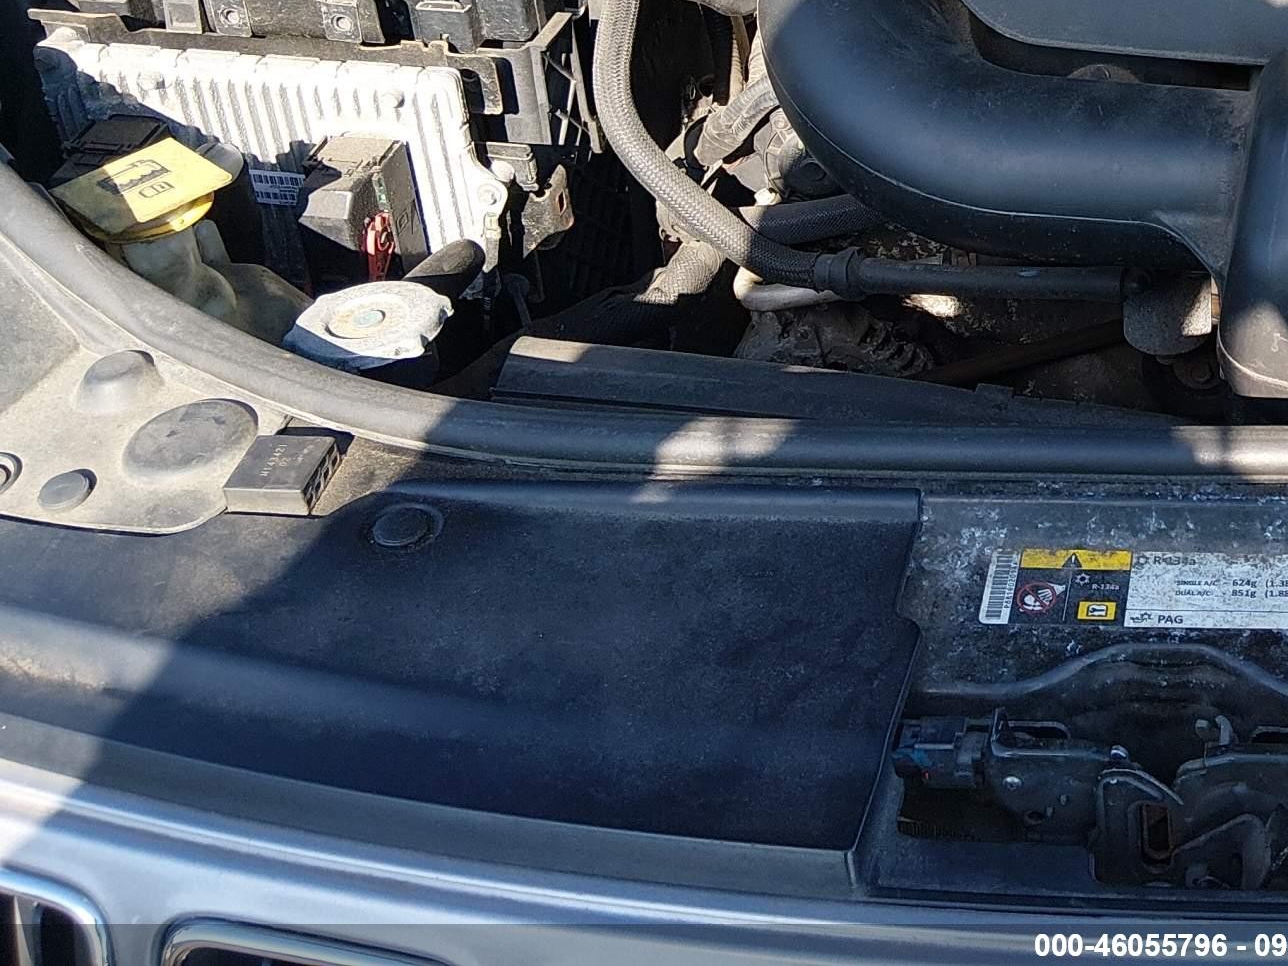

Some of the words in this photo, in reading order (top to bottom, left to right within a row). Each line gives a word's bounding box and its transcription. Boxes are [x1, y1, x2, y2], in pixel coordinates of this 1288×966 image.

[1232, 578, 1257, 589] 624g
[1231, 589, 1257, 599] 851g
[1157, 615, 1184, 625] PAG
